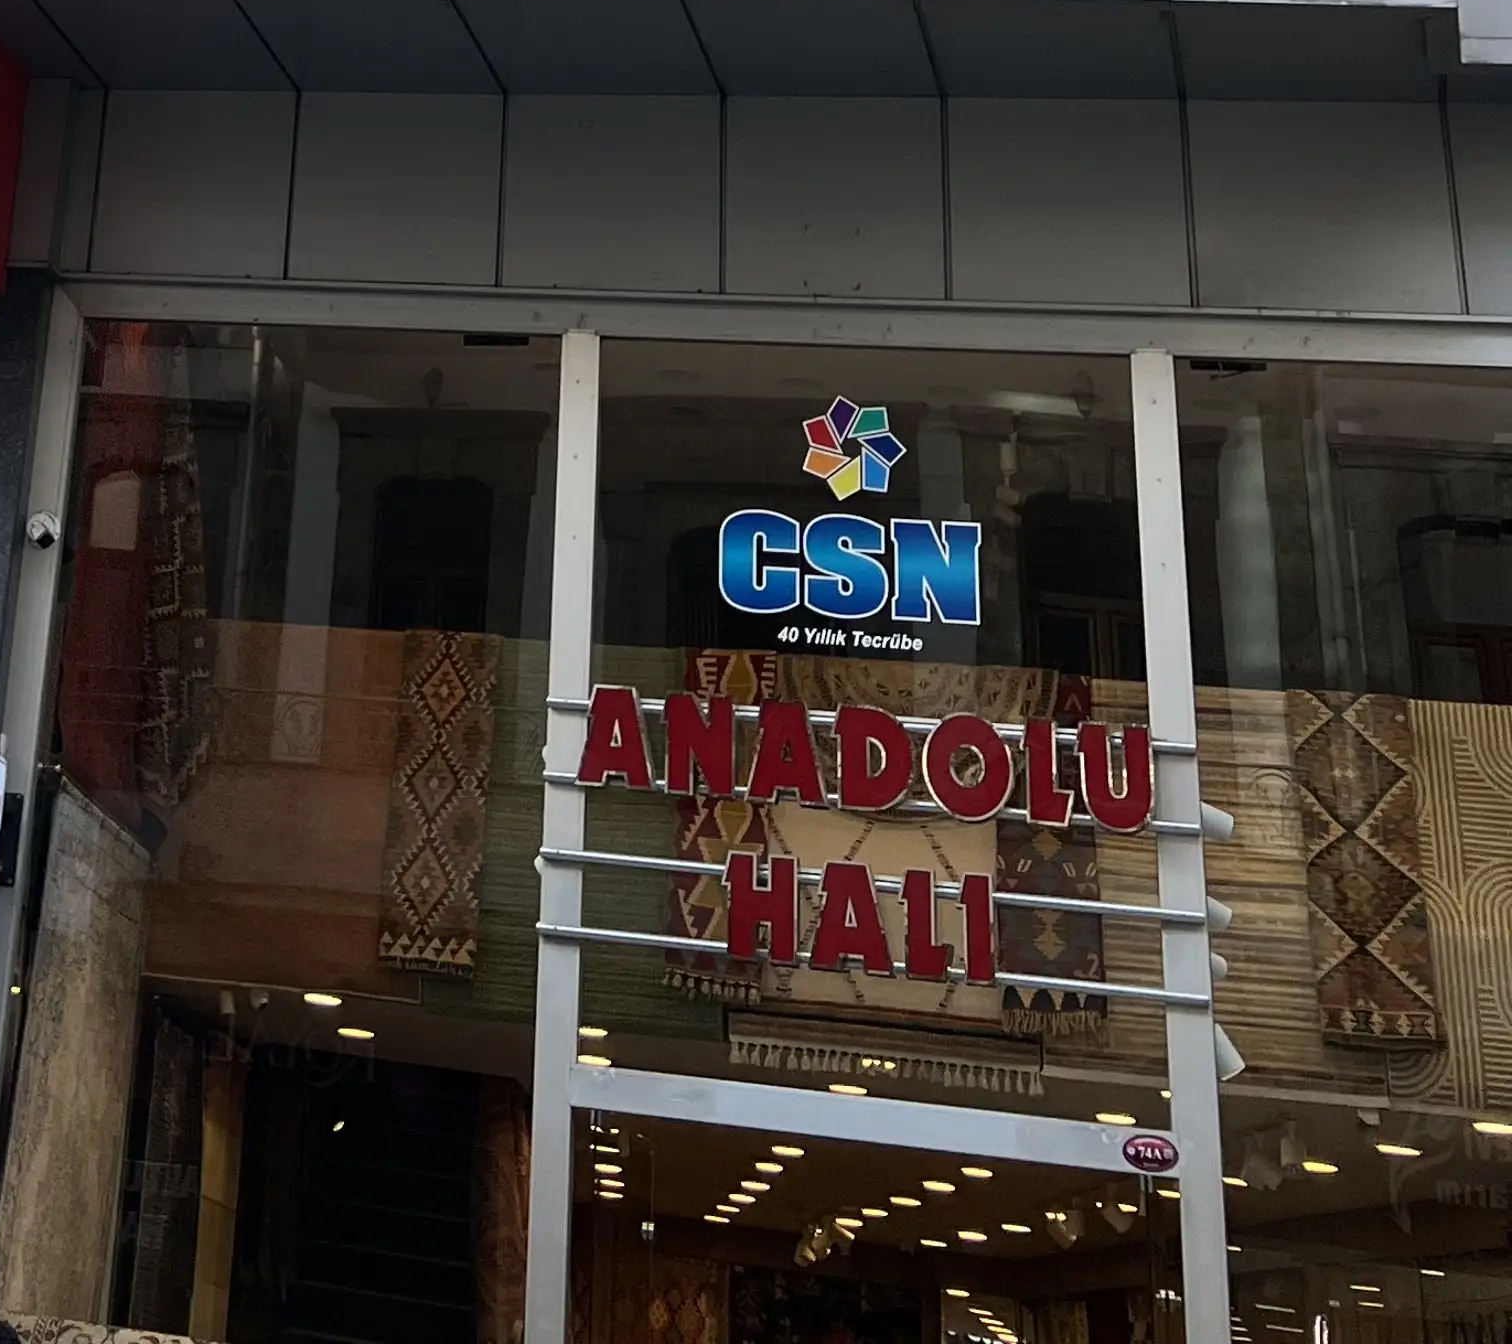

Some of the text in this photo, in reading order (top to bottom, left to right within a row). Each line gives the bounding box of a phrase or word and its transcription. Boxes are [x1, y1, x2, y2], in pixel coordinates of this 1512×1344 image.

[718, 508, 982, 625] CSN
[777, 625, 924, 653] 40 Yıllık Tecrübe
[574, 682, 1156, 833] ANADOLU
[722, 850, 996, 988] HALI
[1137, 1146, 1163, 1160] 74A
